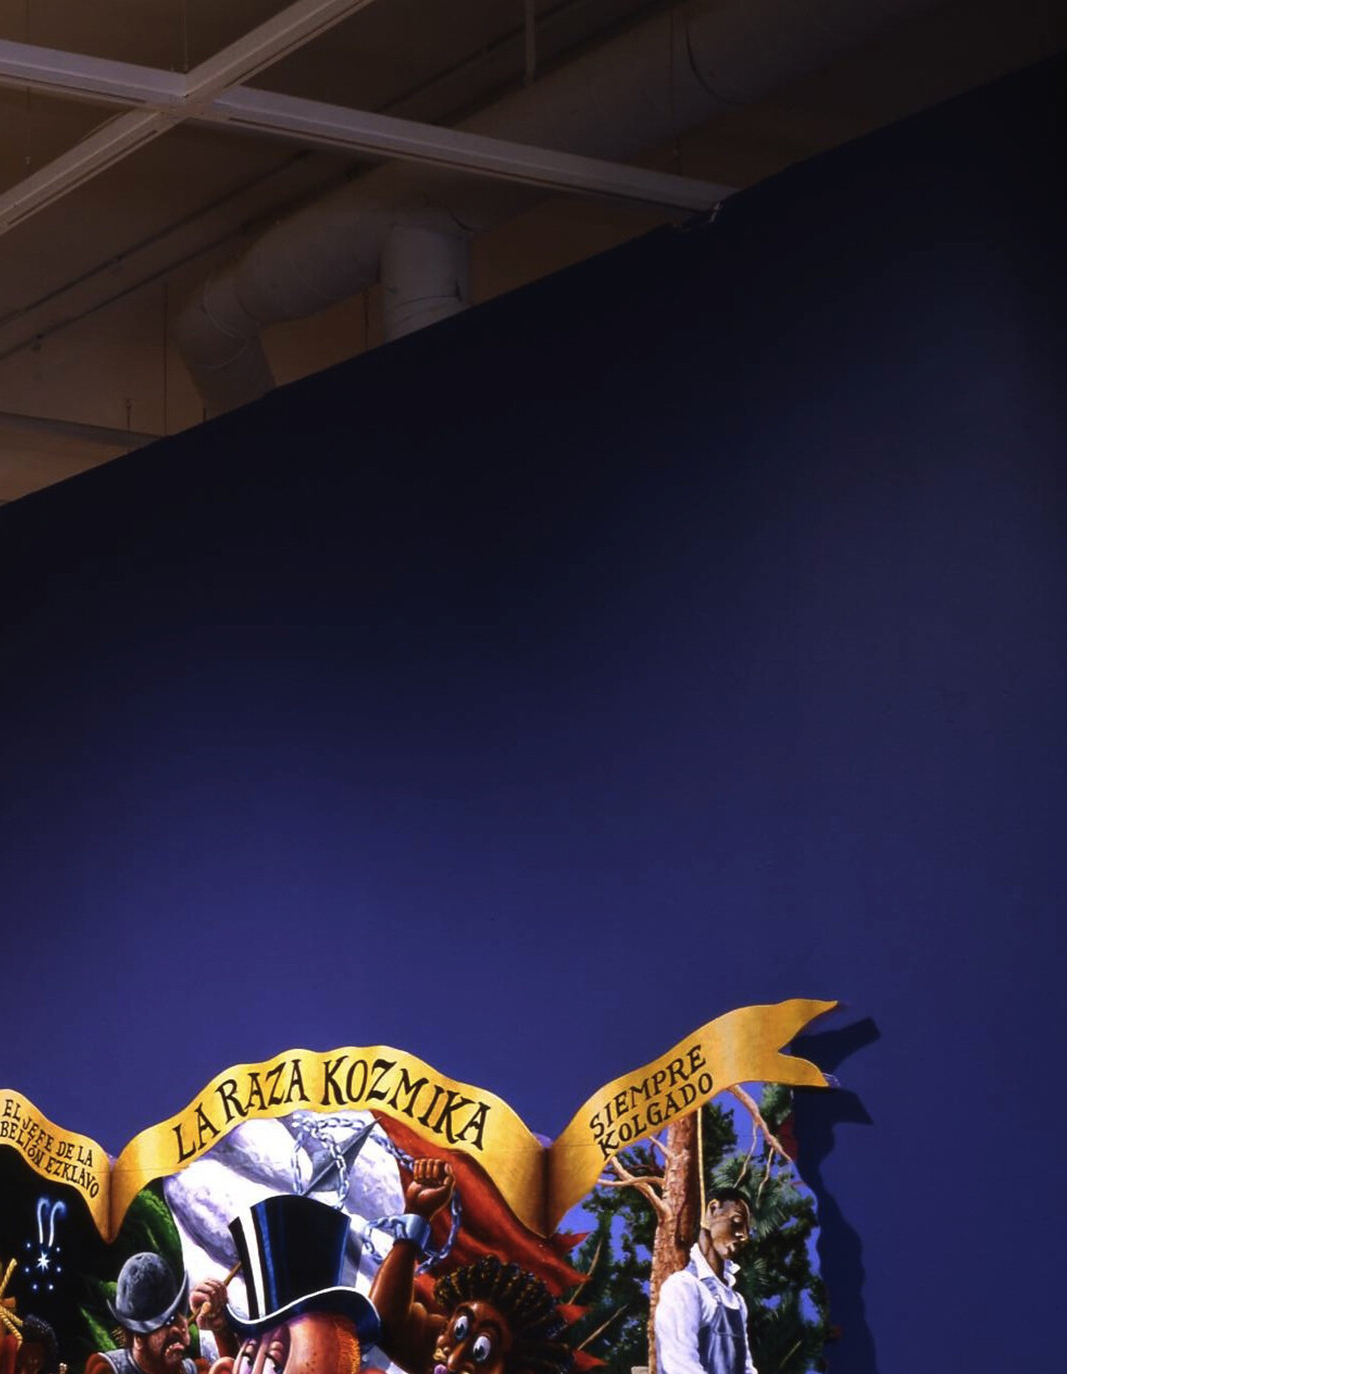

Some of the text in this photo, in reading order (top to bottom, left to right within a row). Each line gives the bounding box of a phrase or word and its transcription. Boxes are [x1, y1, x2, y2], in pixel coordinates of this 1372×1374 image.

[3, 1099, 93, 1168] EL JEFE DE LA
[172, 1055, 492, 1164] LA RAZA KOZMIKA
[589, 1044, 706, 1142] SIEMPRE
[597, 1073, 713, 1161] KOLGADO
[45, 1154, 100, 1199] EZKLAVO
